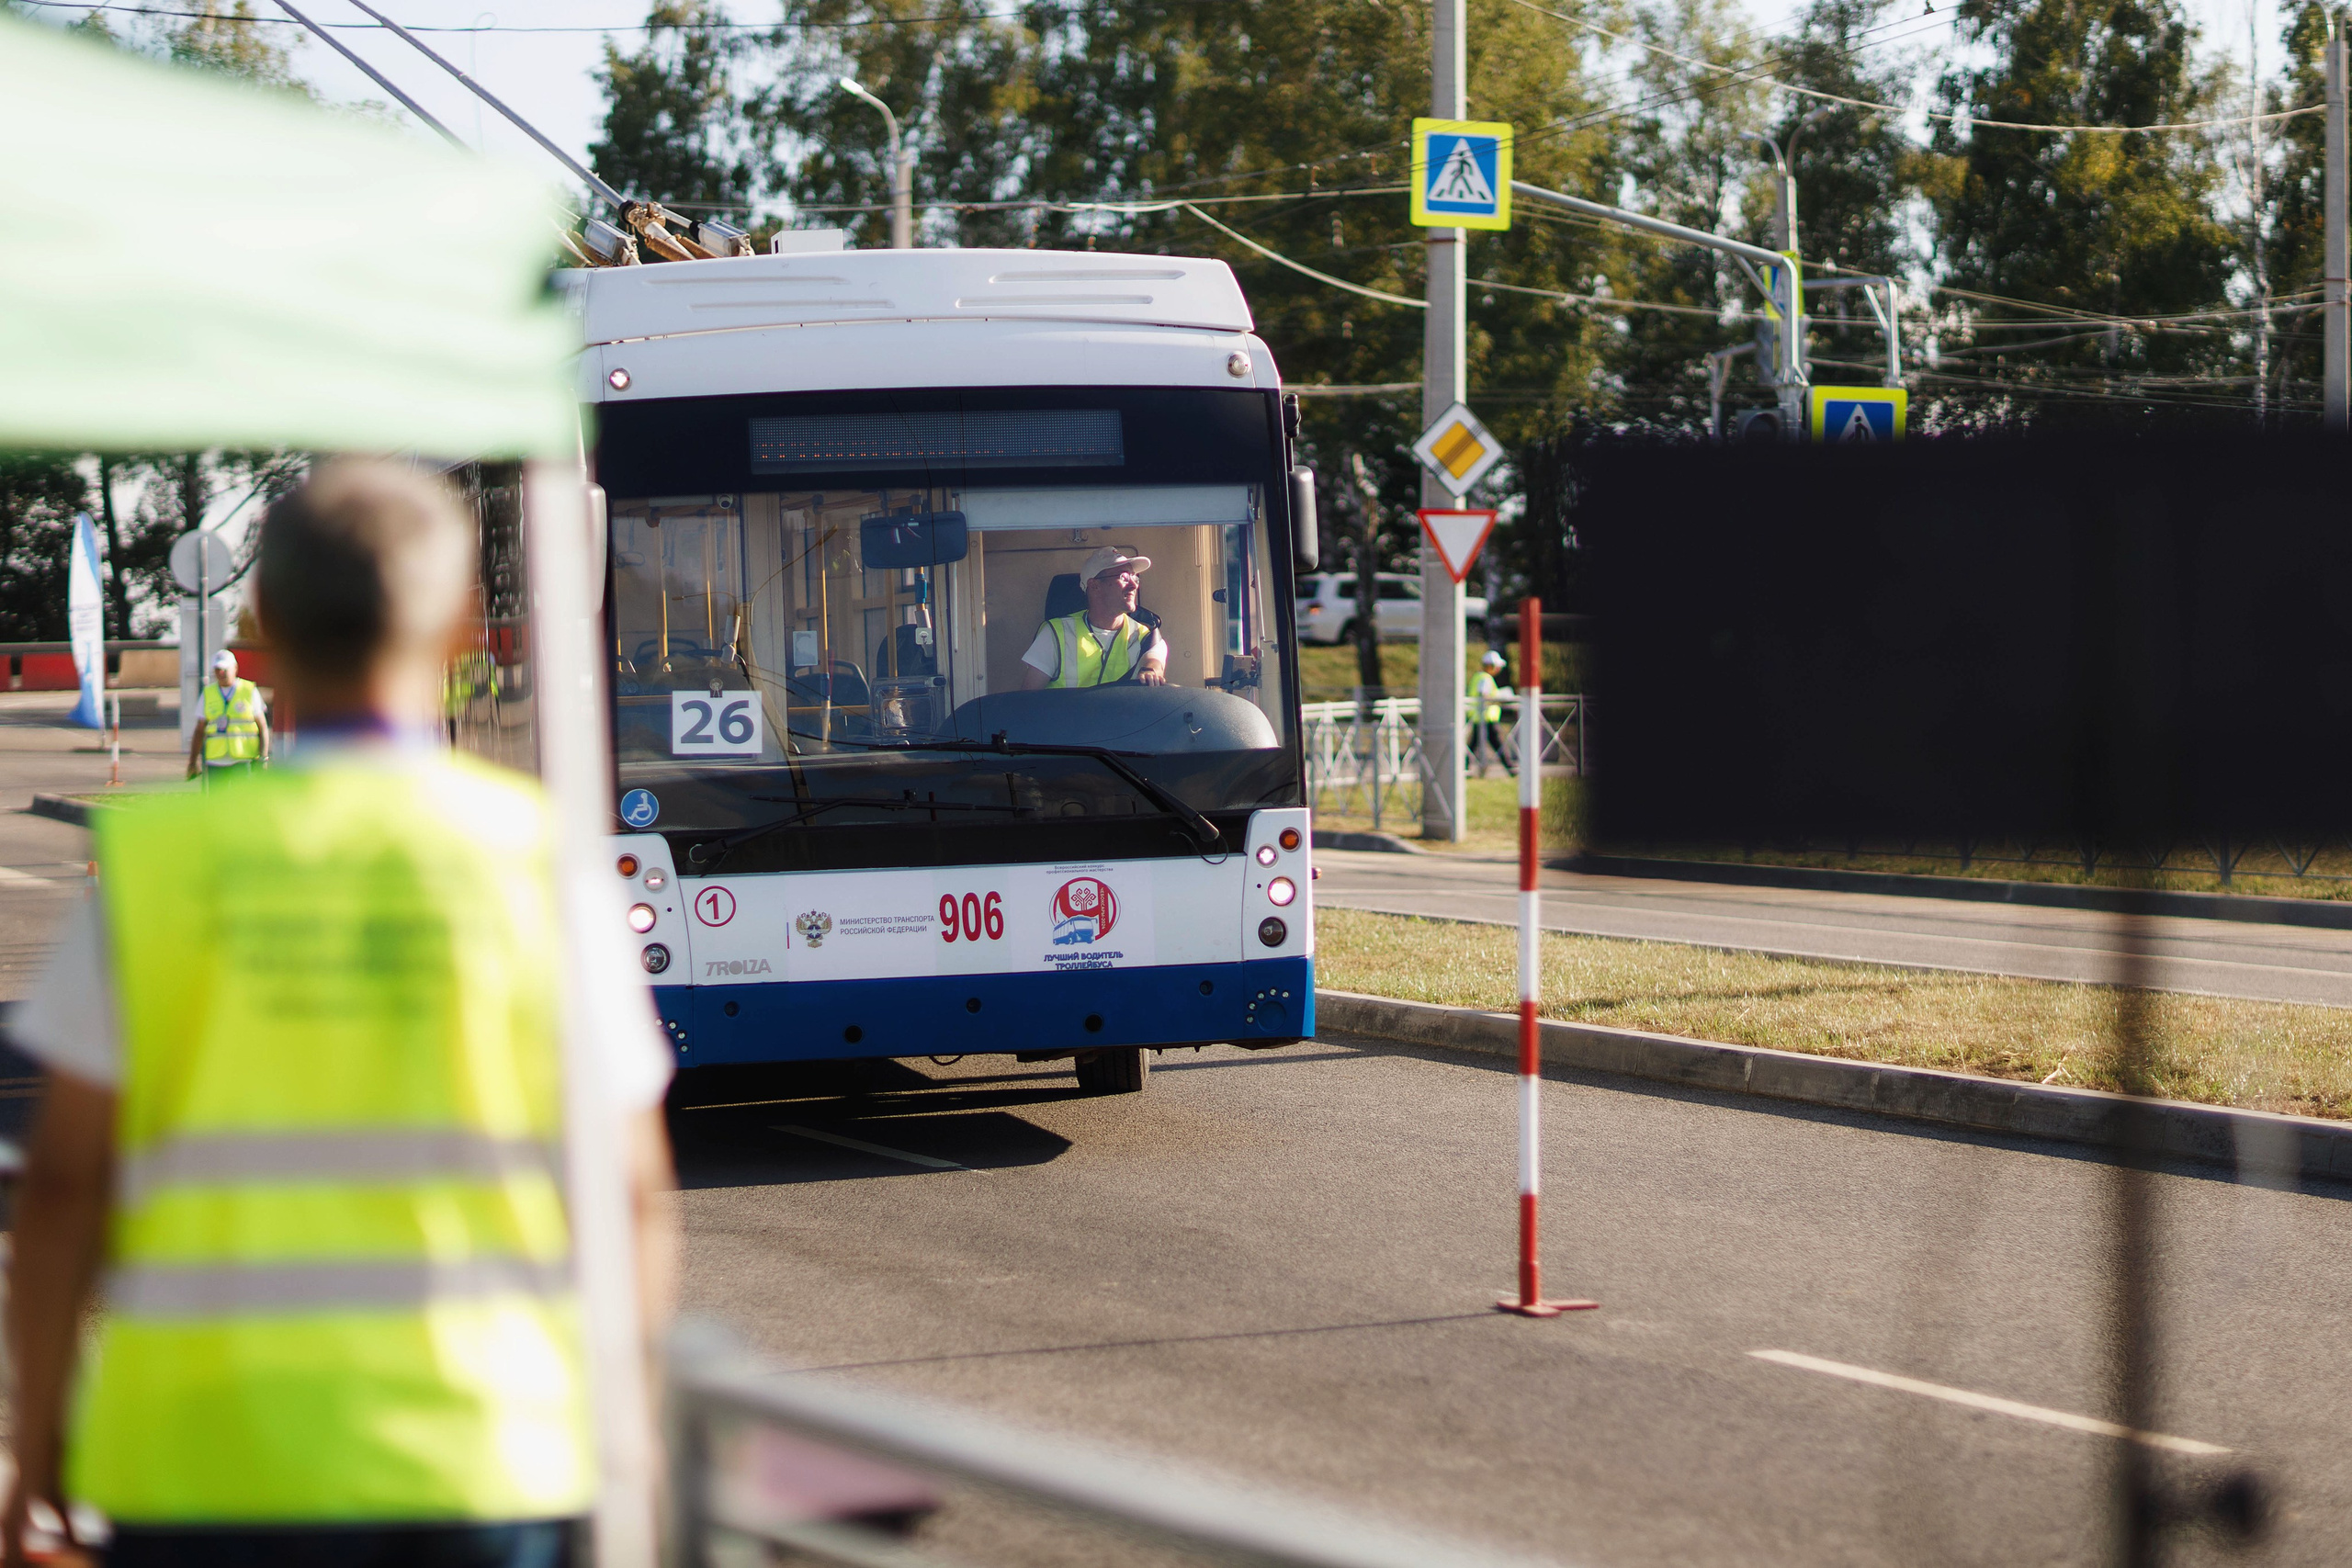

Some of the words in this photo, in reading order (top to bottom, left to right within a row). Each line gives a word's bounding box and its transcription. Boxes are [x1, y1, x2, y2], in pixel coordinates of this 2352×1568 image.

[680, 700, 754, 744] 26
[706, 893, 719, 919] 1
[840, 917, 893, 926] МИНИСТЕРСТВО
[894, 915, 935, 924] ТРАНСПОРТА
[939, 891, 1004, 943] 906
[840, 925, 886, 935] РОССИЙСКОЙ
[887, 925, 927, 934] ФЕДЕРАЦИИ
[1044, 952, 1080, 962] ЛУЧШИЙ
[1081, 951, 1124, 961] ВОДИТЕЛЬ
[1055, 960, 1114, 970] ТРОЛЛЕЙБУСА
